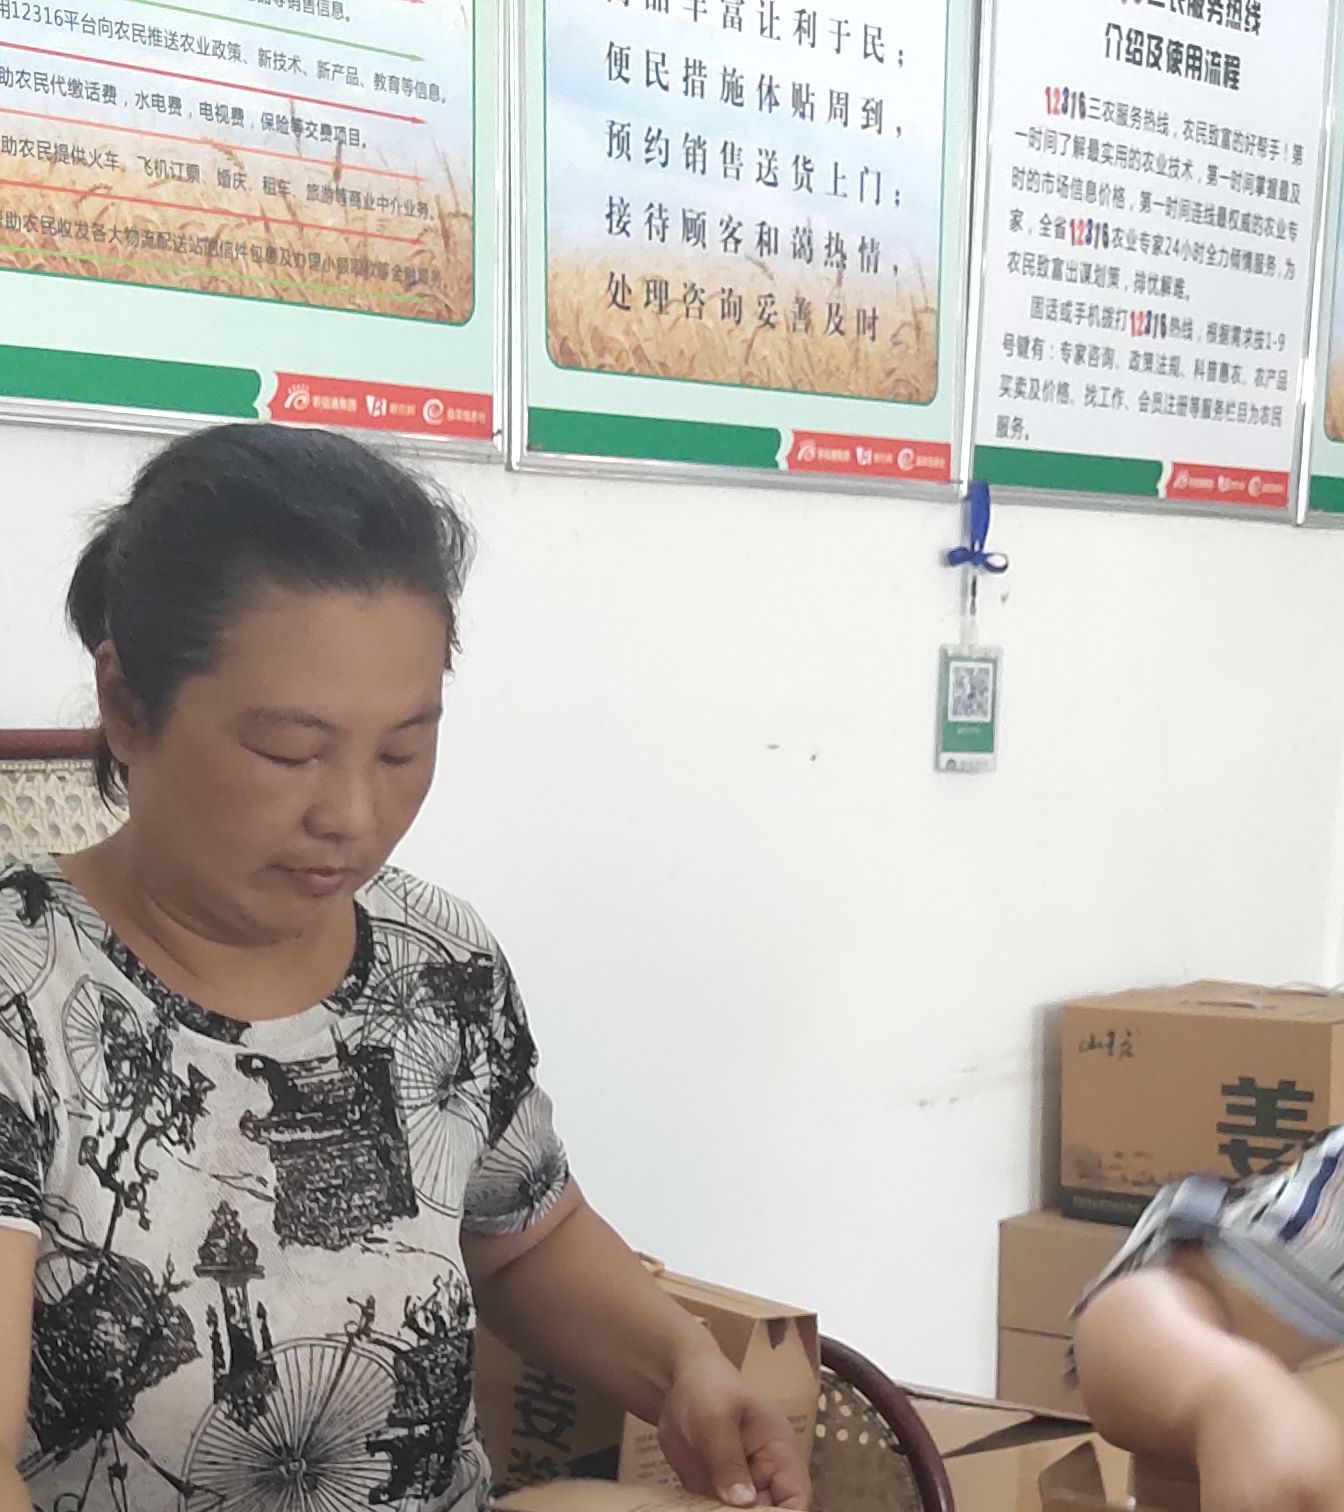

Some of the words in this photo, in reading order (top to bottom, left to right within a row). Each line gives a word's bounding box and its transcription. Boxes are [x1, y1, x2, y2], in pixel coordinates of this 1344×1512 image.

[605, 41, 903, 138] 便民措施体贴周到，
[1104, 22, 1242, 90] 介绍及使用流程
[604, 119, 903, 209] 预约销售送货上门；
[604, 195, 900, 276] 接待顾客和蔼热情，
